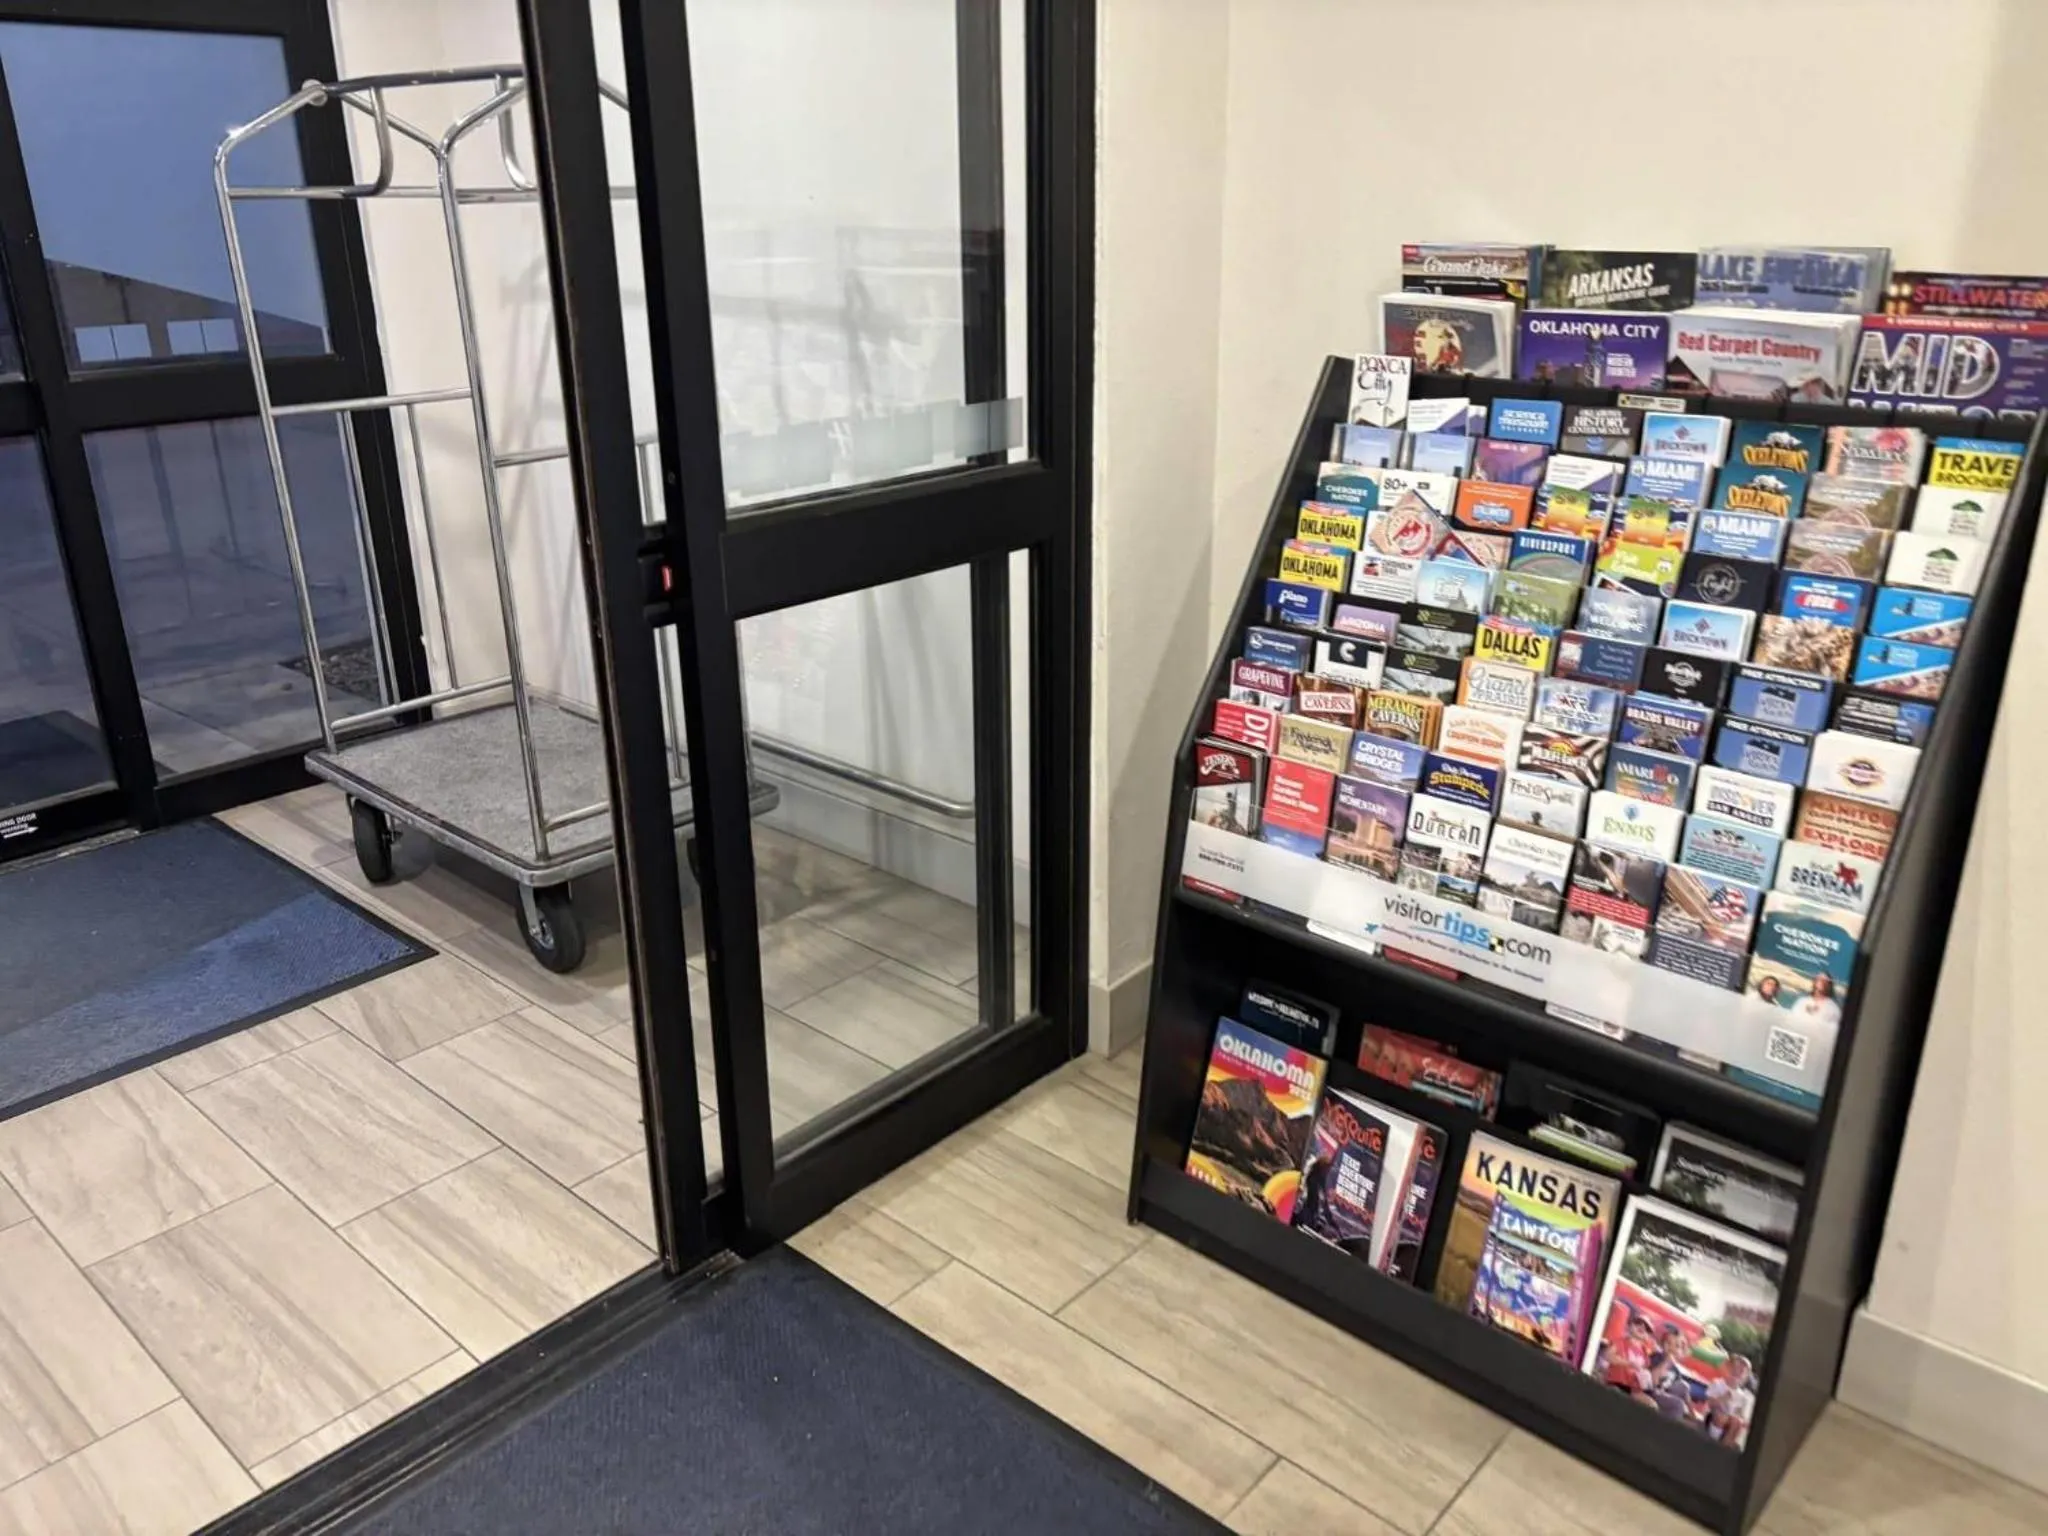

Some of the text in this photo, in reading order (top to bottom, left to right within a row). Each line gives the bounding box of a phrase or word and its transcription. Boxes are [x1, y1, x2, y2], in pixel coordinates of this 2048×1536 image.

[1567, 262, 1655, 298] ARKANSAS
[1530, 319, 1661, 339] OKLAHOMA CITY
[1677, 331, 1703, 350] Red
[1708, 334, 1760, 354] Carpet
[1763, 338, 1822, 363] Country
[1851, 331, 2000, 400] MID
[1574, 416, 1625, 428] HISTORY
[1937, 452, 2013, 477] TRAVE
[1325, 484, 1368, 497] CHEROKEE
[1331, 493, 1361, 503] NATION
[1299, 517, 1357, 541] OKLAHOMA
[1282, 556, 1338, 580] OKLAHOMA
[1482, 627, 1542, 659] DALLAS
[1238, 666, 1286, 690] GRAPEVINE
[1368, 697, 1424, 718] MERAMEC
[1626, 706, 1700, 732] BRAZOS VALLEY
[1370, 708, 1421, 732] CAVERNS
[1356, 754, 1403, 774] BRIDGES
[1358, 741, 1405, 763] CRYSTAL
[1414, 812, 1481, 845] DUNCAN
[1603, 816, 1656, 843] ENNIS
[1790, 866, 1863, 901] BRENHAM
[1773, 922, 1841, 952] CHEROKEE
[1781, 936, 1830, 957] NATION
[1219, 1035, 1315, 1088] OKLAHOMA
[1477, 1151, 1601, 1220] KANSAS
